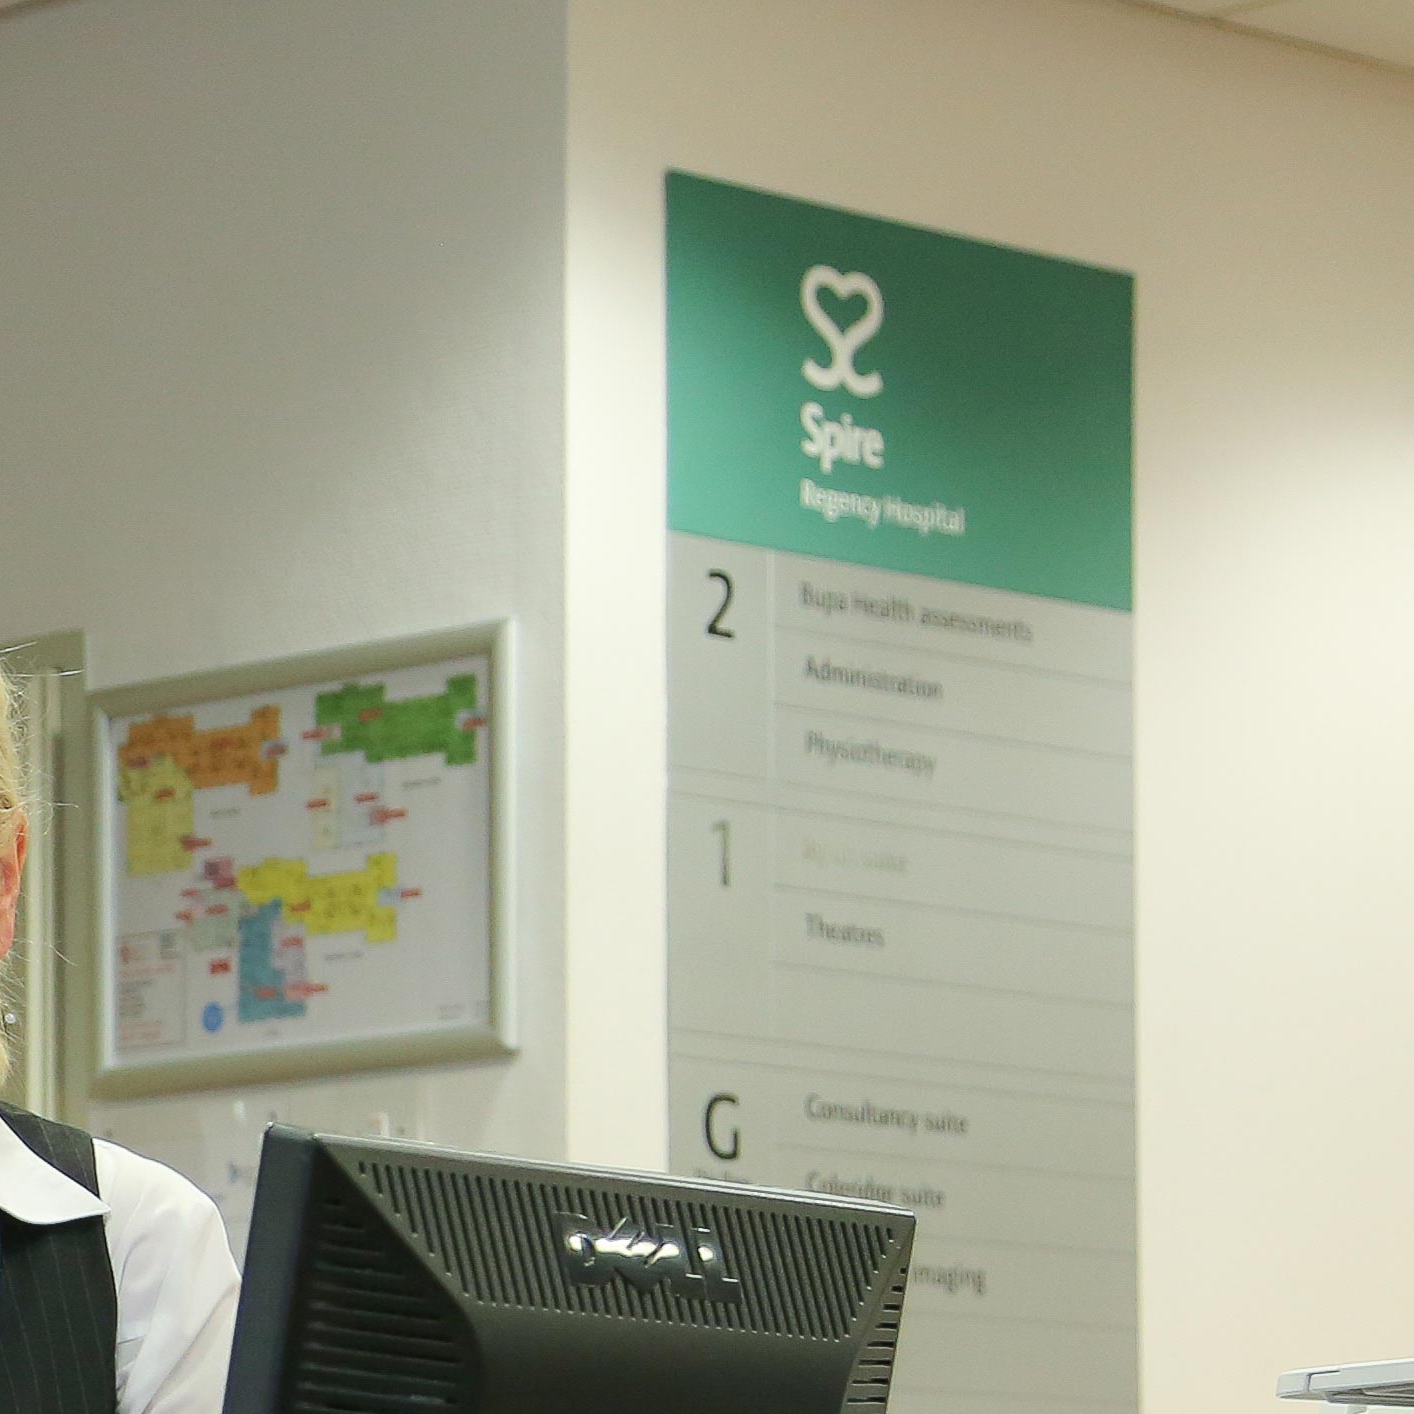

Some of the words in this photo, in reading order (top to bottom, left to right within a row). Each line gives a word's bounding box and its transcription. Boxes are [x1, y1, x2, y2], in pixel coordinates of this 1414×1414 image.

[800, 401, 885, 474] Spire
[800, 479, 880, 526] Regency
[882, 494, 966, 537] Hospital
[706, 567, 735, 639] 2
[800, 580, 847, 615] Bupa
[851, 592, 915, 622] Health
[920, 605, 1033, 644] assessments
[804, 654, 944, 700] Administration
[805, 729, 938, 780] Physiotherapy
[711, 819, 732, 887] 1
[804, 911, 886, 949] Theatres
[703, 1092, 740, 1161] G
[804, 1092, 919, 1139] Consultancy
[924, 1108, 970, 1136] suite
[900, 1184, 947, 1210] suite
